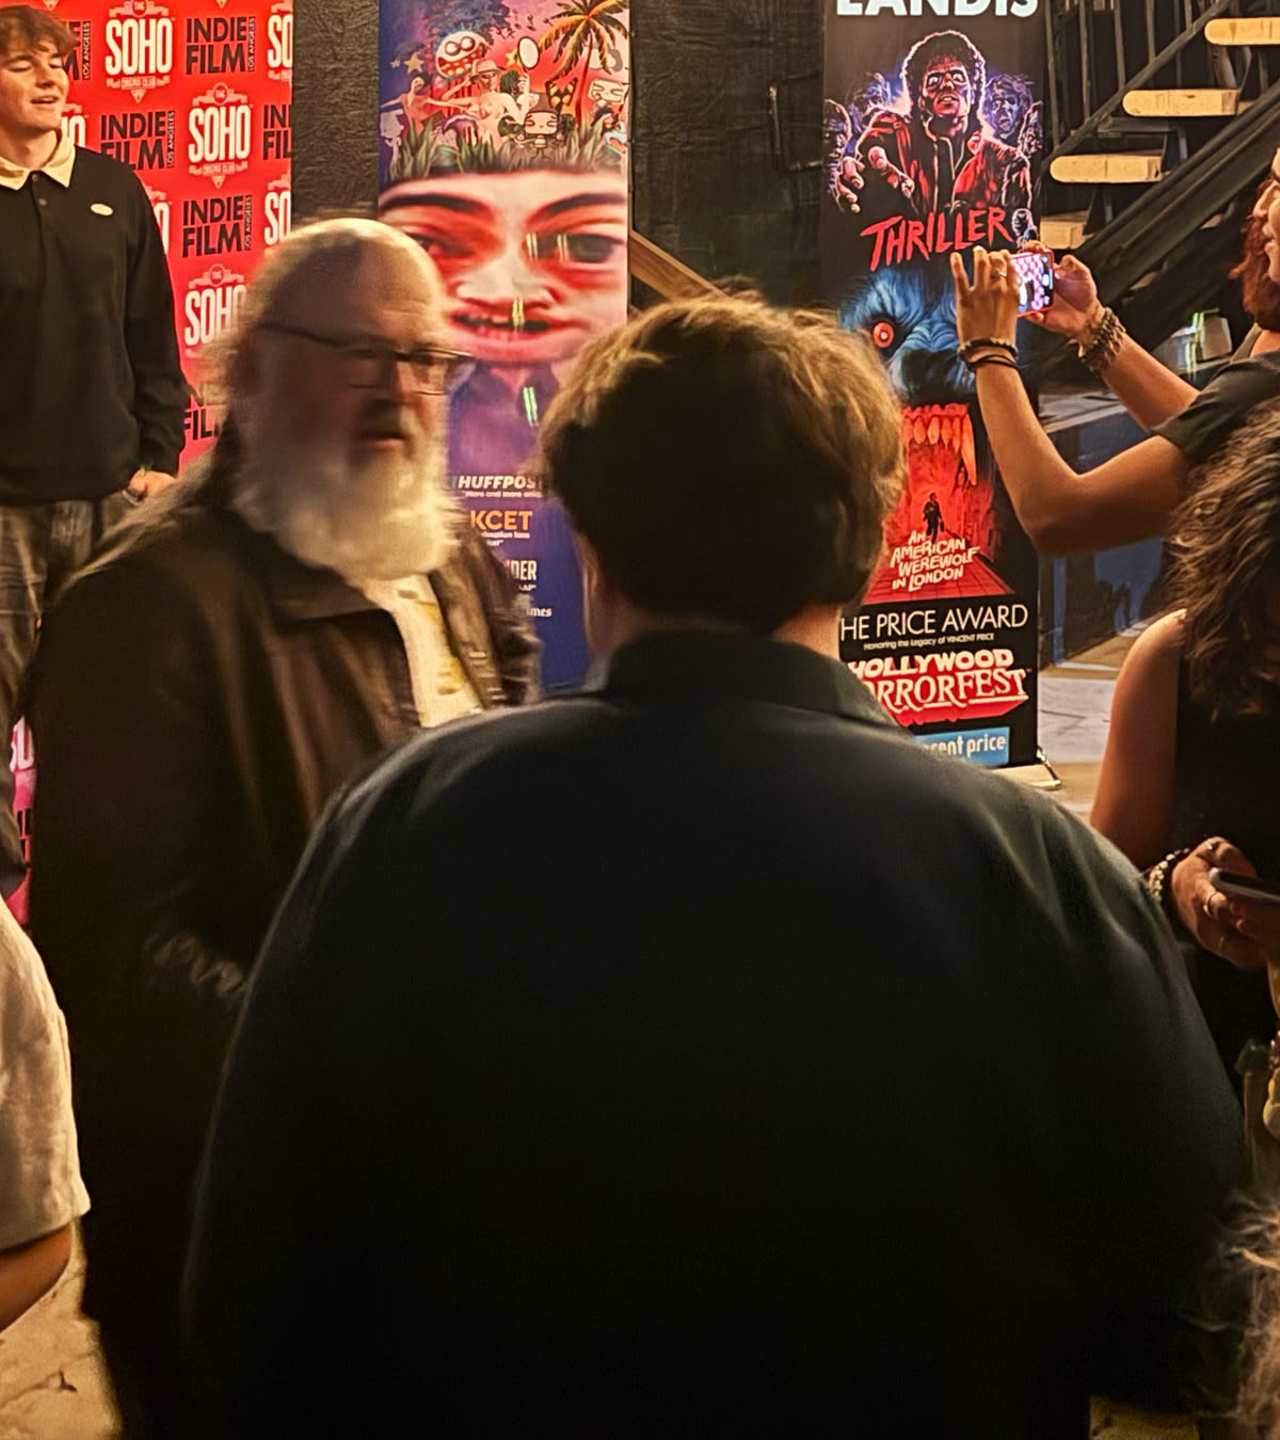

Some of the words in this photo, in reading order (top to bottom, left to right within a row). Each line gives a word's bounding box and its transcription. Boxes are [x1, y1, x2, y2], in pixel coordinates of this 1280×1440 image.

[186, 16, 247, 43] INDIE
[267, 14, 293, 68] SO
[105, 17, 173, 76] SOHO
[185, 43, 246, 75] FILM
[101, 111, 166, 141] INDIE
[188, 104, 251, 163] SOHO
[263, 131, 291, 160] FIL
[183, 195, 243, 226] INDIE
[264, 191, 292, 246] SO
[182, 223, 242, 258] FILM
[860, 205, 1014, 272] THRILLER
[470, 510, 533, 531] KCET
[890, 537, 966, 568] AMERICAN
[907, 529, 926, 545] AN
[898, 546, 981, 577] WEREWOLF
[891, 577, 907, 590] IN
[908, 564, 964, 592] LONDON
[840, 615, 870, 641] HE
[876, 610, 936, 637] PRICE
[941, 604, 1029, 632] AWARD
[847, 647, 1015, 680] HOLLYWOOD
[863, 667, 1028, 714] RRORFEST
[966, 733, 1007, 758] price
